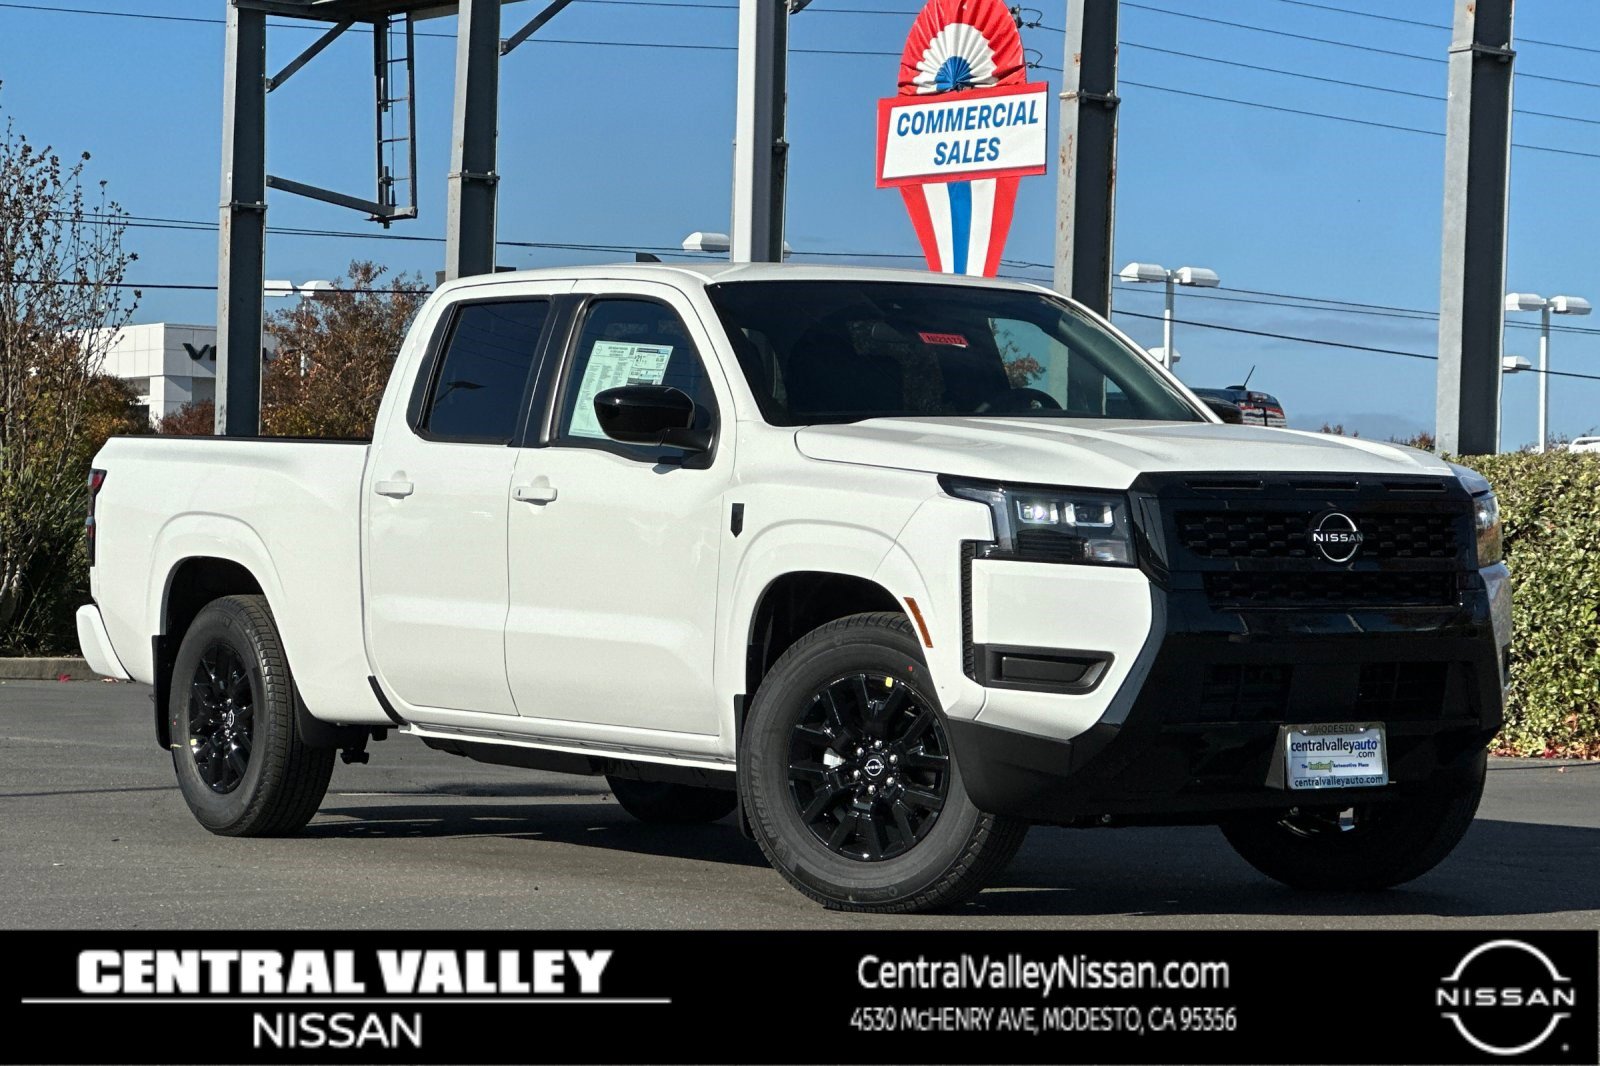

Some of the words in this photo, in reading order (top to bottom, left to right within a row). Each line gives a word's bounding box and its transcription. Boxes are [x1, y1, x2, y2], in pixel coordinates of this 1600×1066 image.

[897, 99, 1039, 137] COMMERCIAL
[933, 136, 1001, 166] SALES
[1313, 533, 1363, 542] NISSAN
[1314, 724, 1355, 733] MODESTO
[1295, 775, 1383, 788] centralvalleyauto.com
